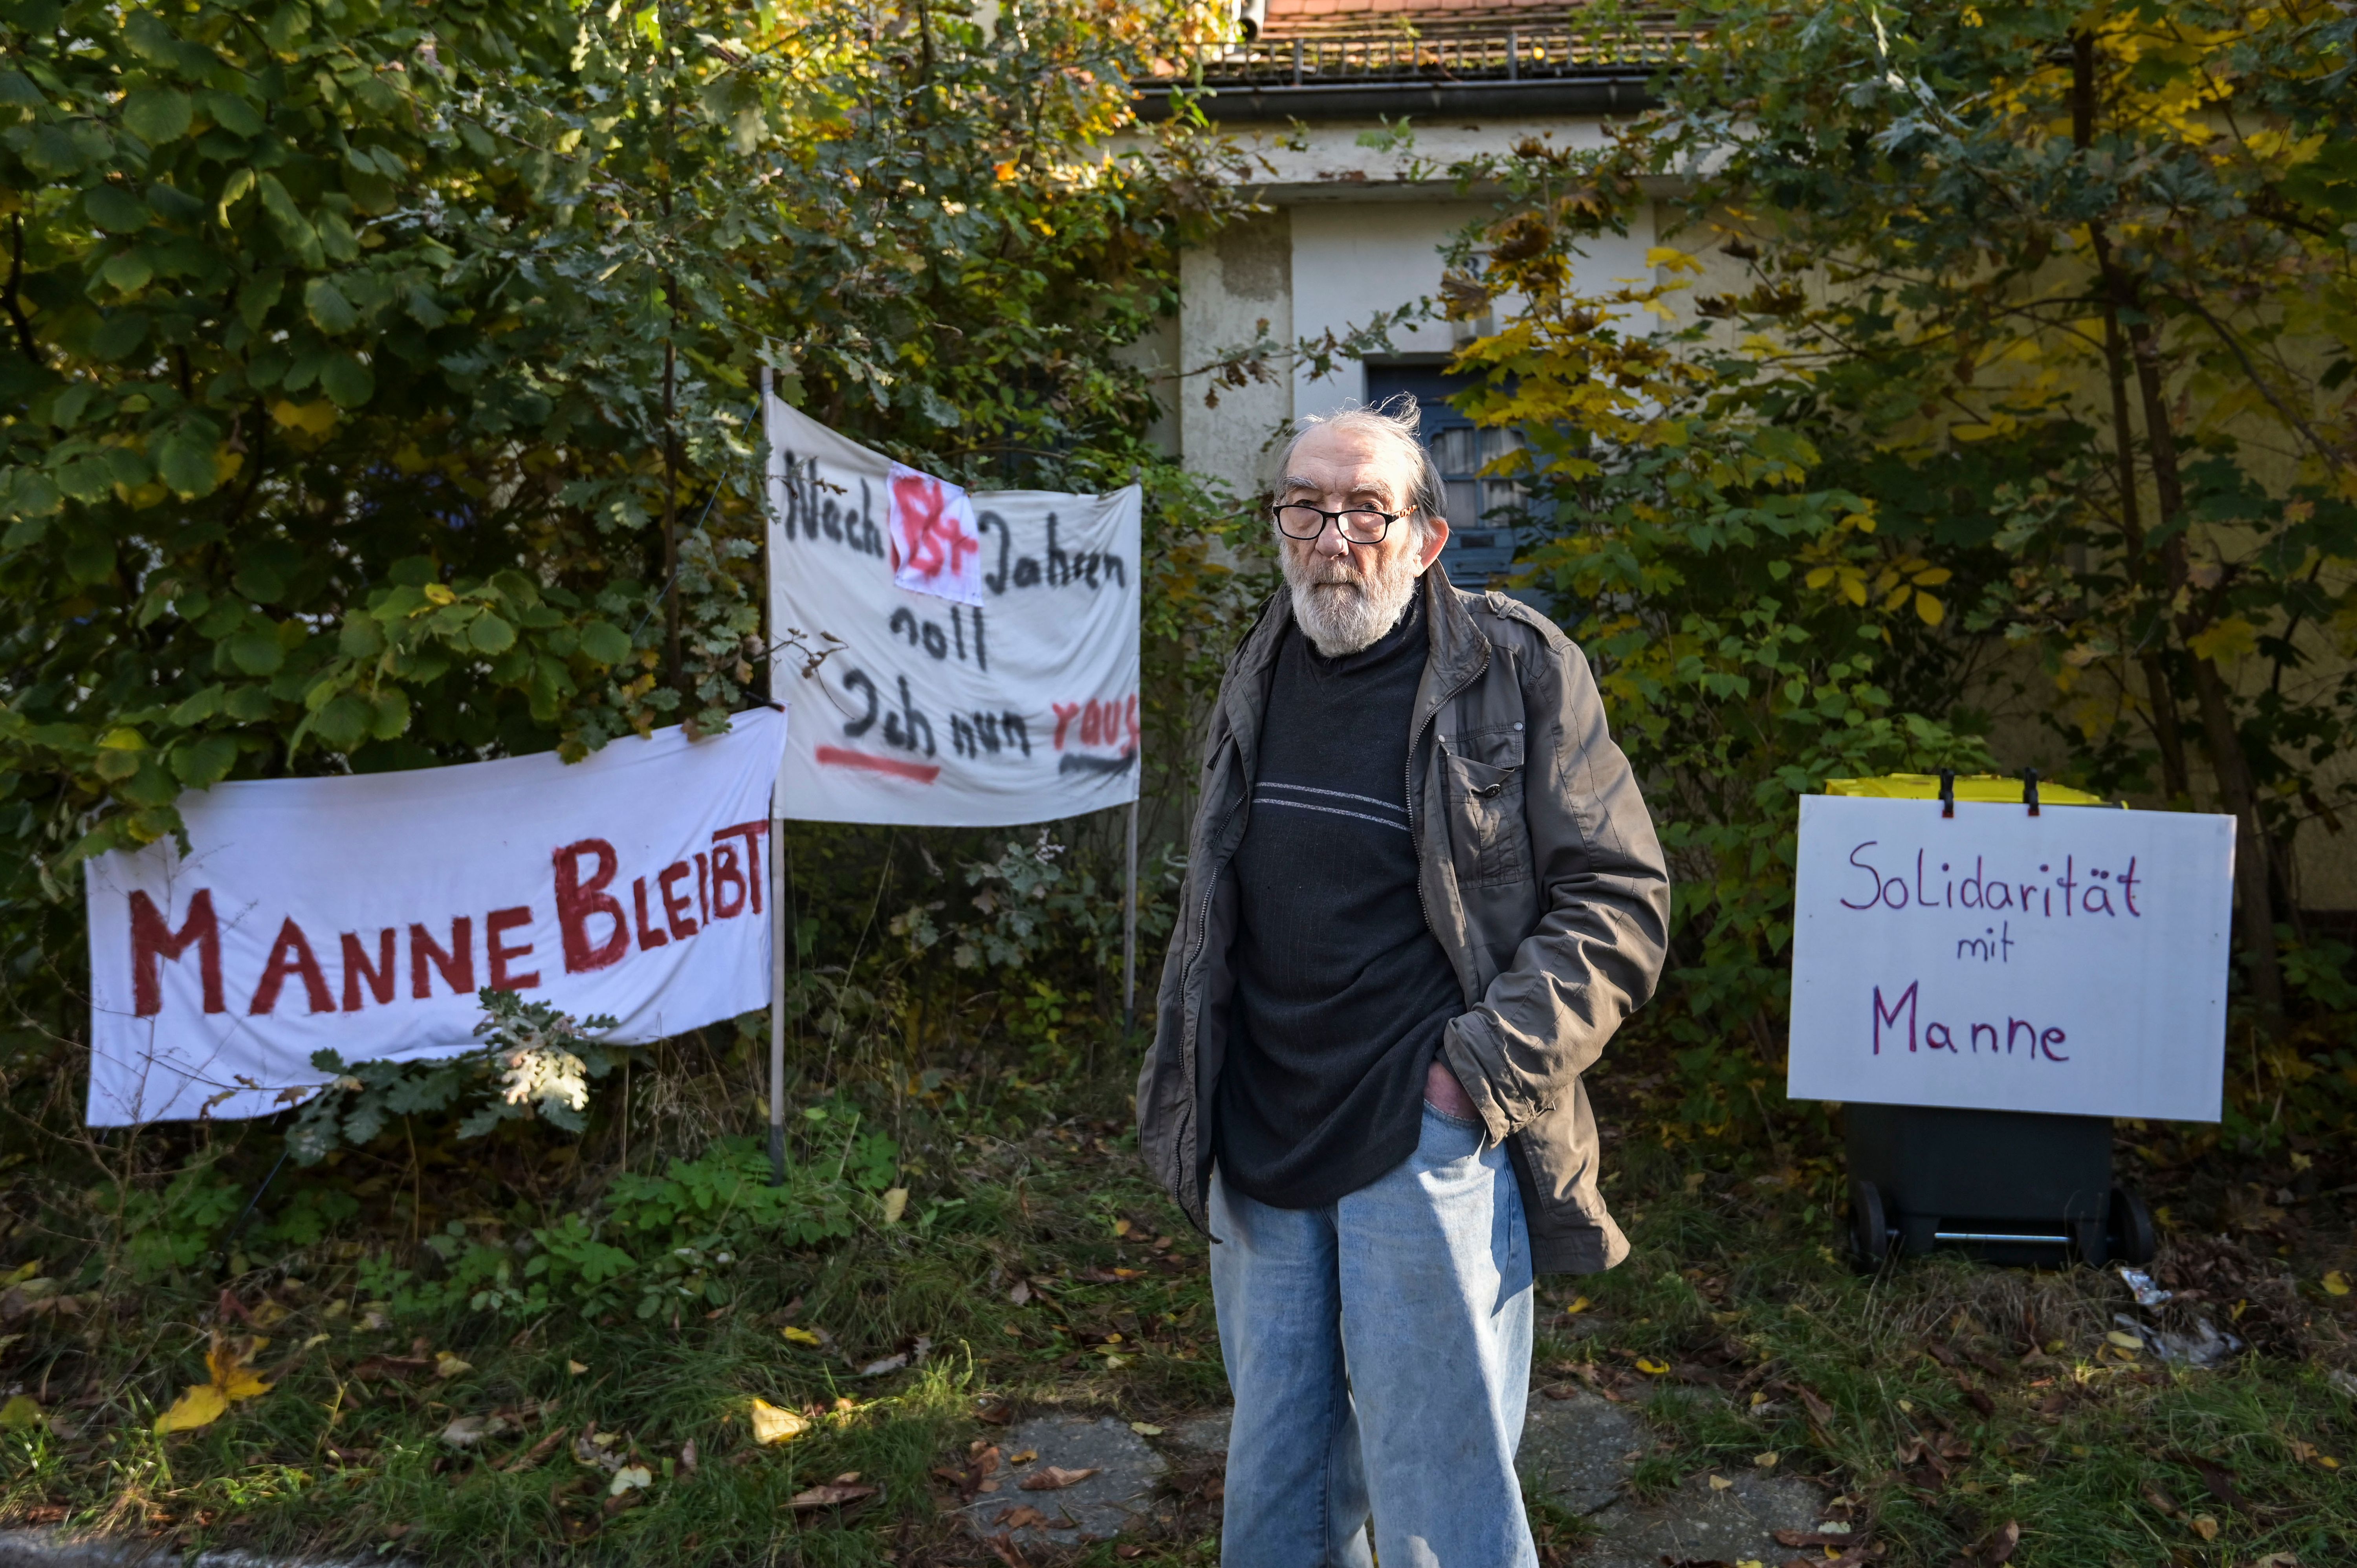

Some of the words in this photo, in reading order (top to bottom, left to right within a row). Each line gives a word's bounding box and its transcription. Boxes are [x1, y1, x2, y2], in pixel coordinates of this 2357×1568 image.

[784, 449, 885, 559] Nach
[977, 511, 1126, 595] Jahren
[950, 711, 1032, 759] nun
[1052, 694, 1140, 757] raus
[1957, 921, 2014, 962] mit
[1873, 980, 2069, 1061] Manne
